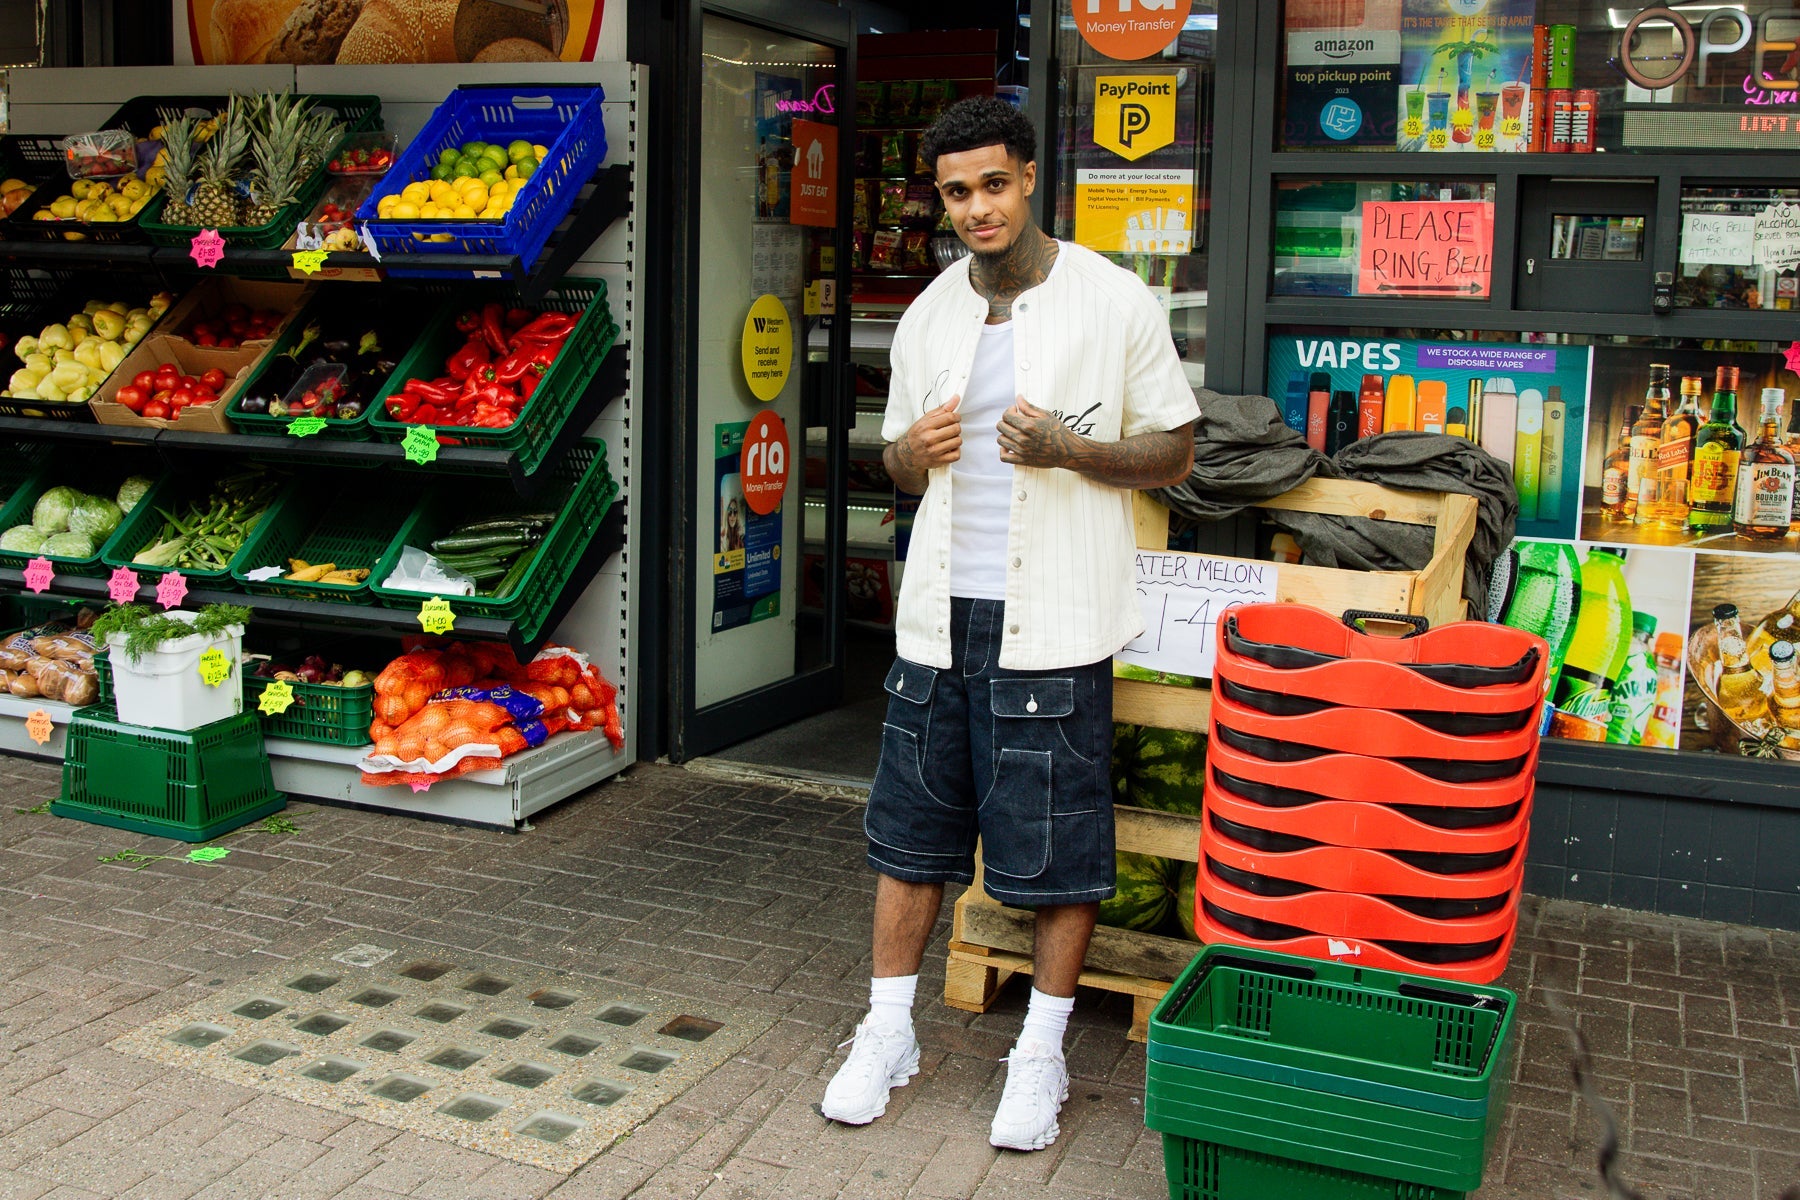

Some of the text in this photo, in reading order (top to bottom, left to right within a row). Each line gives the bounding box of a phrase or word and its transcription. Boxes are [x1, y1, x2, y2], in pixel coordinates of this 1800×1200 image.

[1086, 18, 1176, 34] Money Transfer
[1420, 17, 1432, 28] THE
[1435, 17, 1456, 27] TASTE
[1458, 17, 1476, 27] THAT
[1477, 16, 1496, 27] SETS
[1498, 16, 1507, 26] US
[1507, 16, 1533, 26] APART
[1314, 39, 1374, 52] amazon
[1295, 69, 1392, 84] top pickup point
[1100, 82, 1170, 98] PayPoint
[801, 184, 829, 197] JUST EAT
[1773, 207, 1791, 218] NO
[1373, 206, 1474, 242] PLEASE
[1691, 218, 1752, 233] RING BELL
[1757, 219, 1800, 229] ALCOHOL
[1754, 231, 1781, 241] SERVED
[1373, 247, 1491, 280] RING BELL
[755, 346, 780, 355] Send and
[1296, 340, 1400, 371] VAPES
[1427, 348, 1441, 356] WE
[1442, 349, 1470, 357] STOCK
[1479, 350, 1502, 358] WIDE
[1503, 351, 1533, 360] RANGE
[1534, 352, 1546, 360] OF
[757, 358, 777, 366] receive
[1447, 358, 1524, 369] DISPOSIBLE VAPES
[752, 369, 783, 380] money here
[747, 424, 784, 476] ria
[1658, 446, 1688, 460] Red Label
[1753, 467, 1792, 482] JIM BEAM
[746, 481, 784, 493] Money Transfer
[1755, 493, 1788, 502] BOURBON
[747, 549, 771, 564] Unlimited
[1136, 553, 1263, 584] ATER MELON
[114, 572, 130, 581] CORN
[164, 577, 181, 588] OKRA
